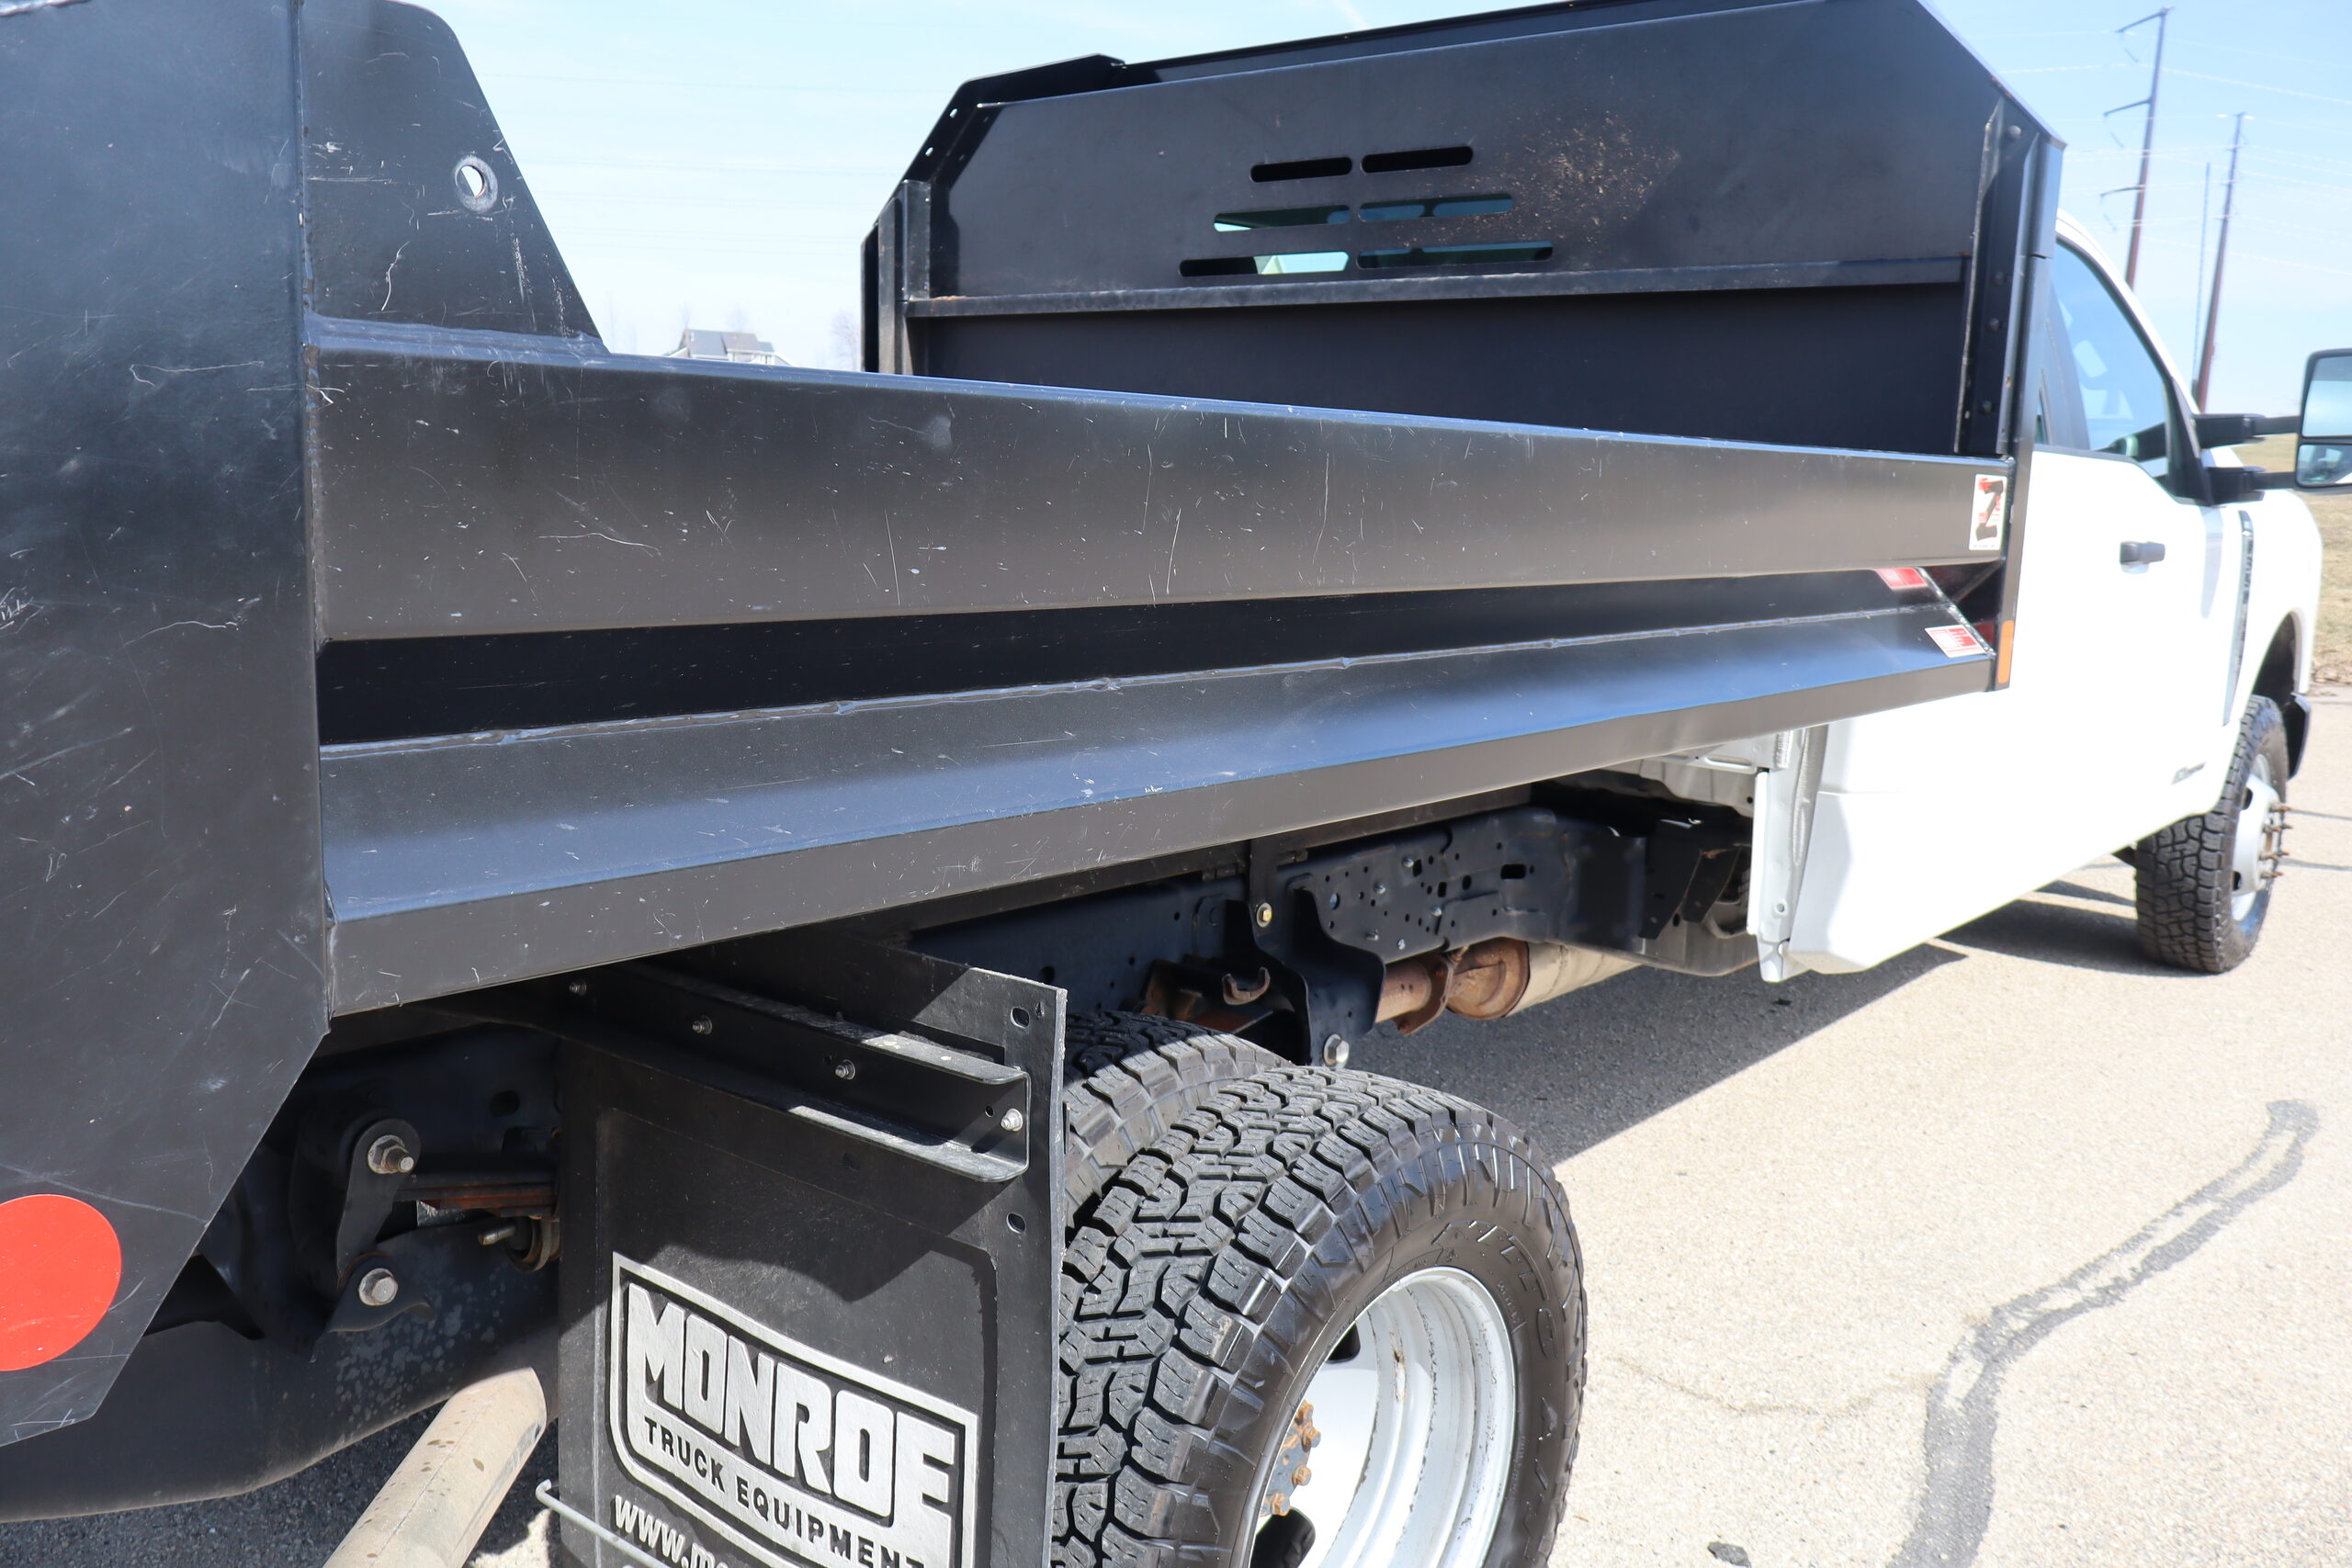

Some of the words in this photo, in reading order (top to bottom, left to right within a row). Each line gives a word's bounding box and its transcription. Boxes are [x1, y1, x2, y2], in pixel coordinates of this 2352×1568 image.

[626, 1282, 956, 1543] MONROE
[644, 1416, 726, 1494] TRUCK
[615, 1495, 729, 1568] www.m
